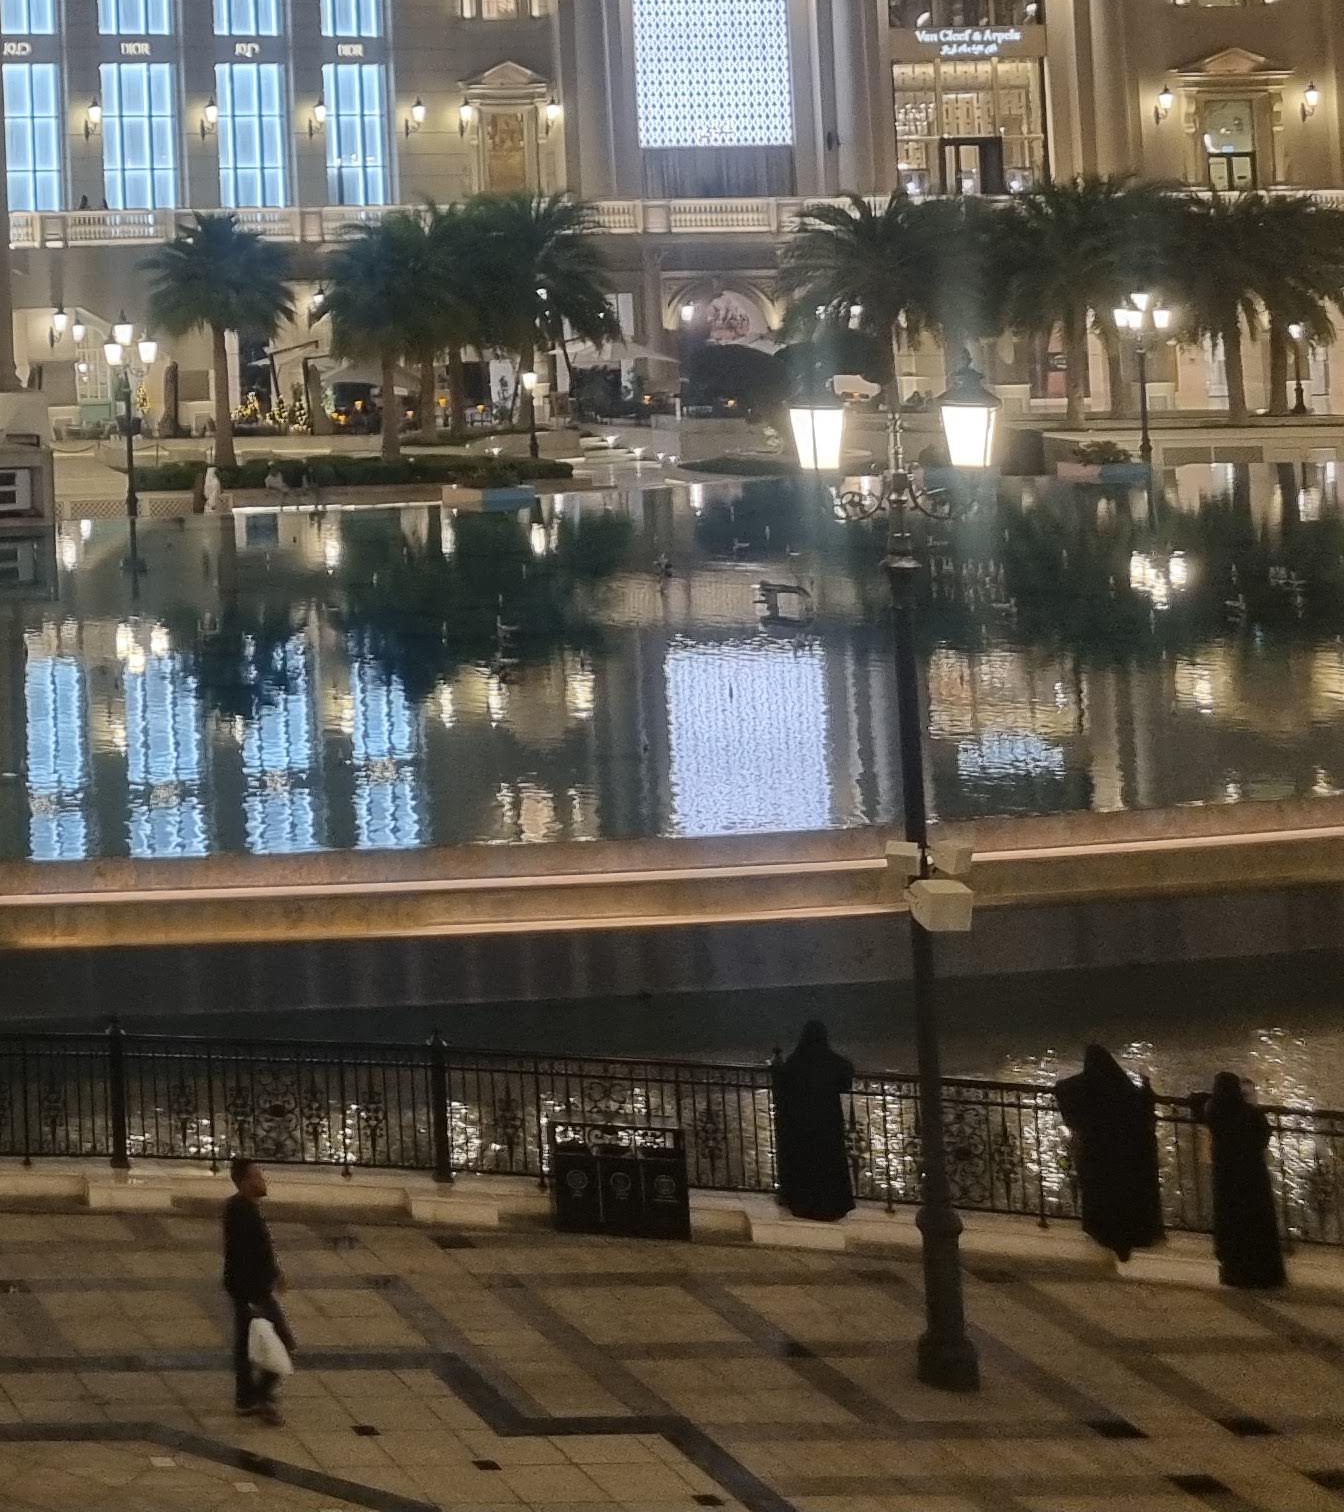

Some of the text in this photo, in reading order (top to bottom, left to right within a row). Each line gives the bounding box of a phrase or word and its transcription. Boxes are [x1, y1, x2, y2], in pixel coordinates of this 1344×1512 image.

[914, 29, 938, 43] Van
[939, 28, 972, 42] Cleef
[983, 28, 1022, 44] Arpels
[120, 42, 152, 56] DIOR
